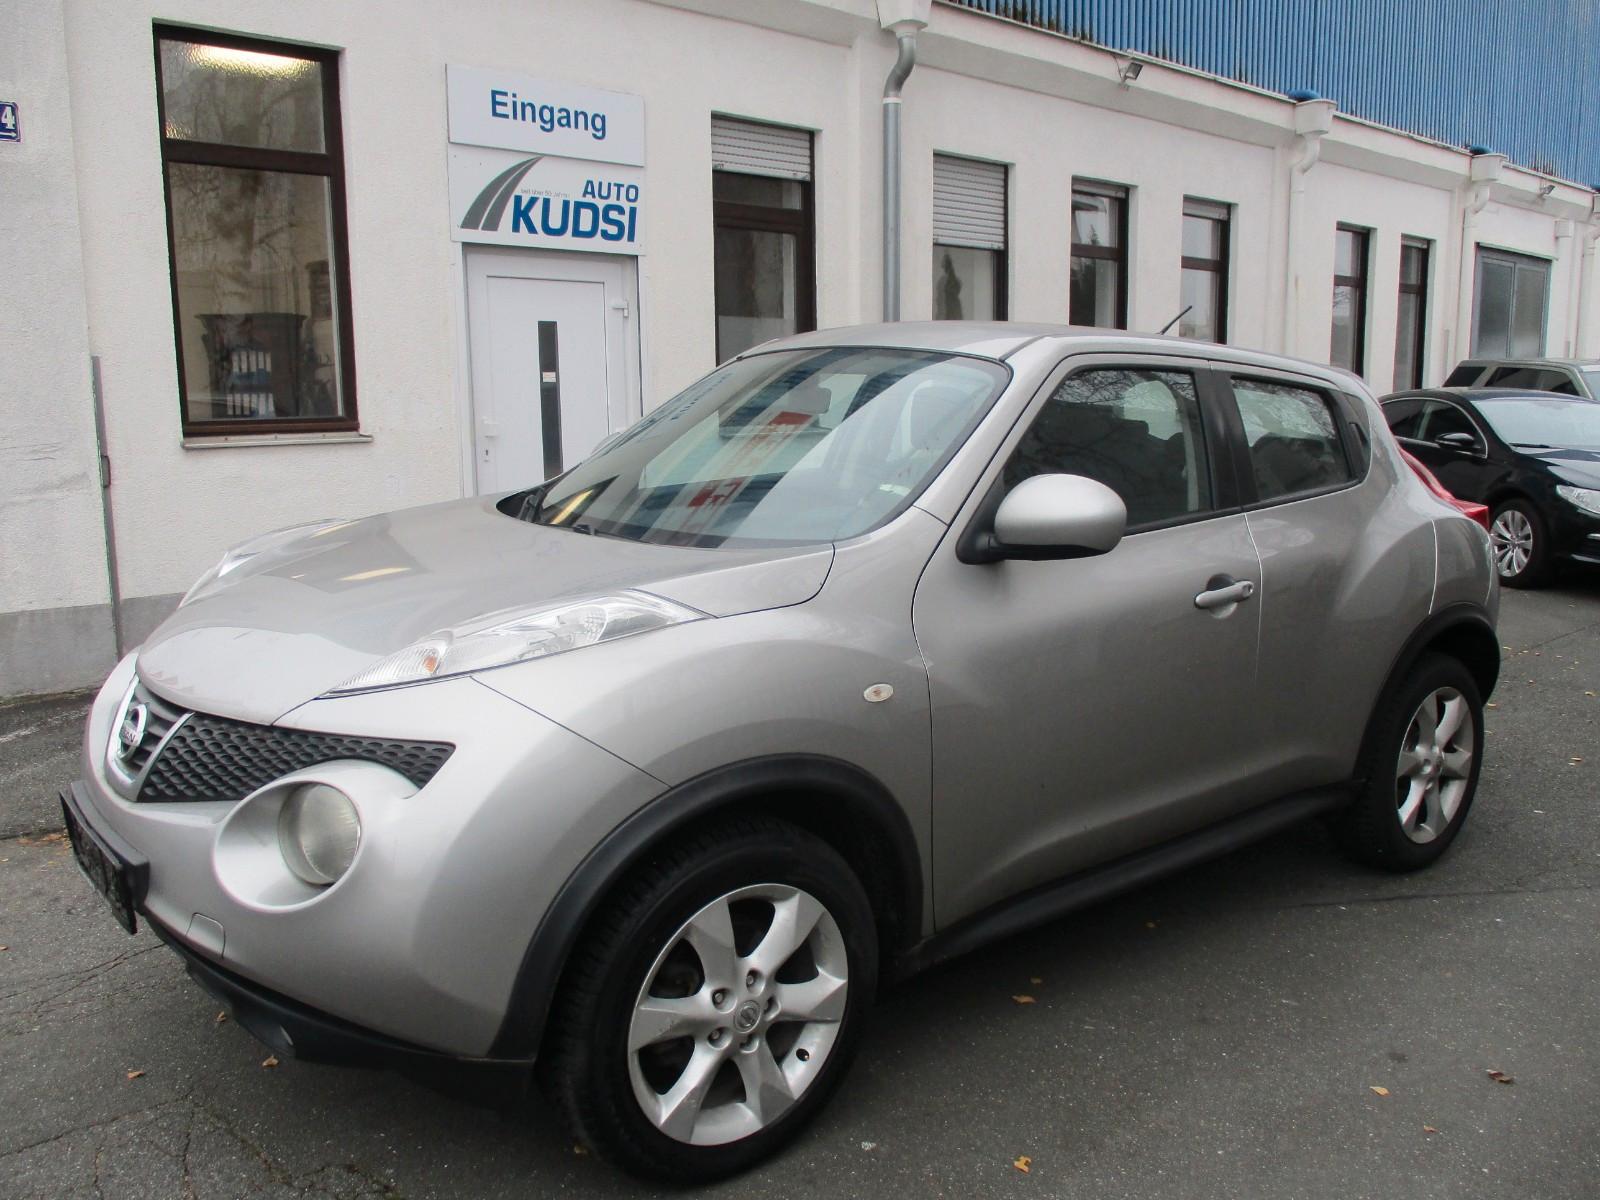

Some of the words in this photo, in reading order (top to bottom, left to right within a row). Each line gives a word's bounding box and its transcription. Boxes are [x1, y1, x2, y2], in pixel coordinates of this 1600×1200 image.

[491, 90, 606, 140] Eingang
[582, 179, 639, 203] AUTO
[512, 195, 637, 243] KUDSI
